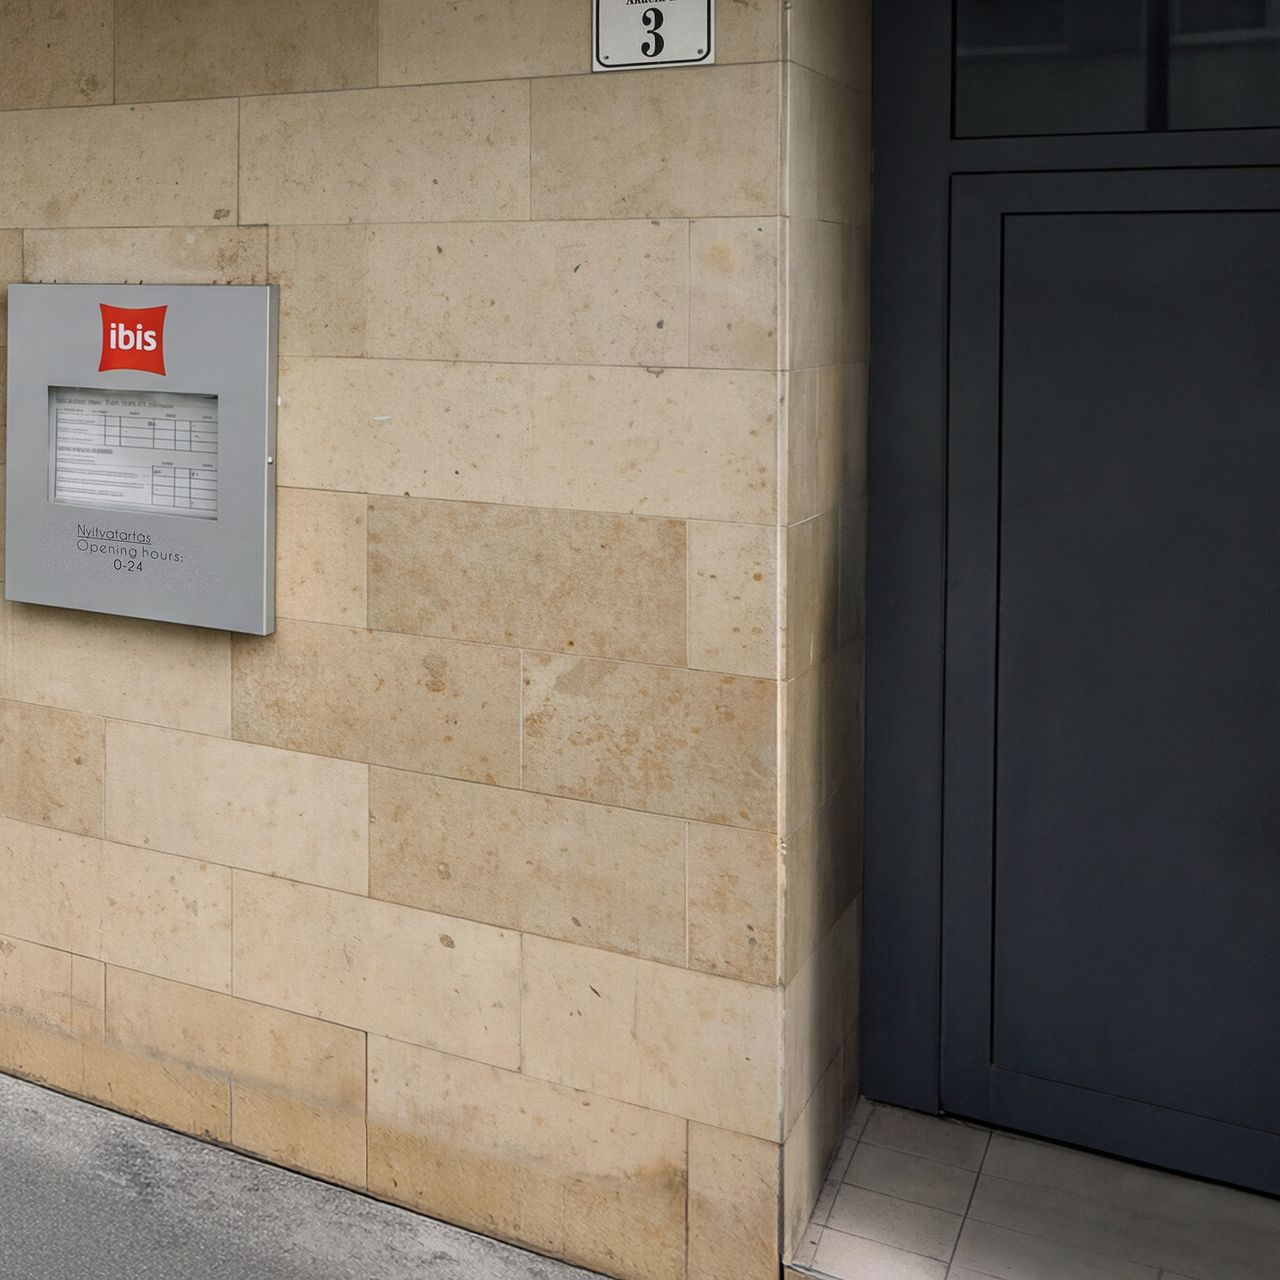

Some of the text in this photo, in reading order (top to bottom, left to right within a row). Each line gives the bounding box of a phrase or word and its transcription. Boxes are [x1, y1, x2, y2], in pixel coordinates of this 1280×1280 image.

[641, 7, 665, 58] 3
[109, 322, 158, 352] ibis
[77, 539, 184, 563] Opening hours:
[113, 558, 143, 572] 0-24
